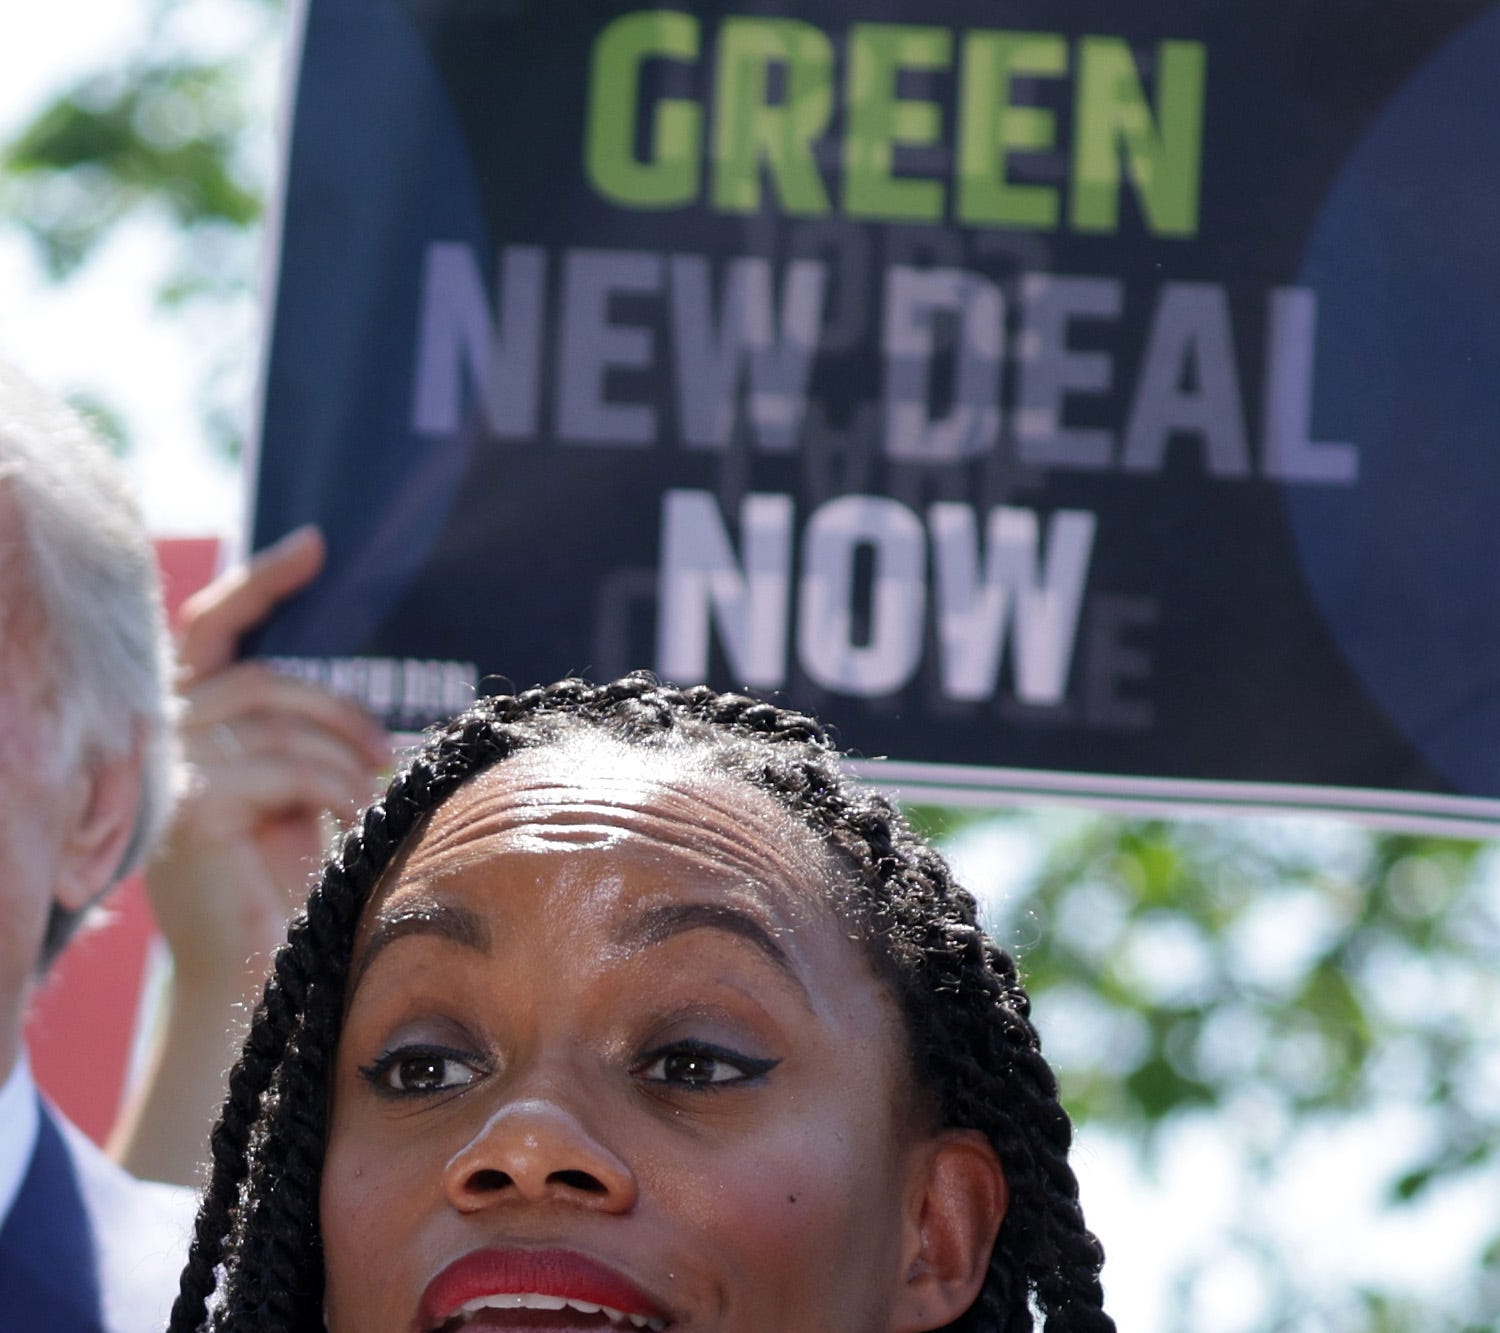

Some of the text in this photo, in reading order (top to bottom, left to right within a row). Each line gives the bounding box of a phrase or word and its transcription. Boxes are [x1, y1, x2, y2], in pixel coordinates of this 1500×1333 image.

[585, 12, 1206, 236] GREEN
[412, 242, 1360, 483] NEW DEAL
[656, 489, 1096, 704] NOW
